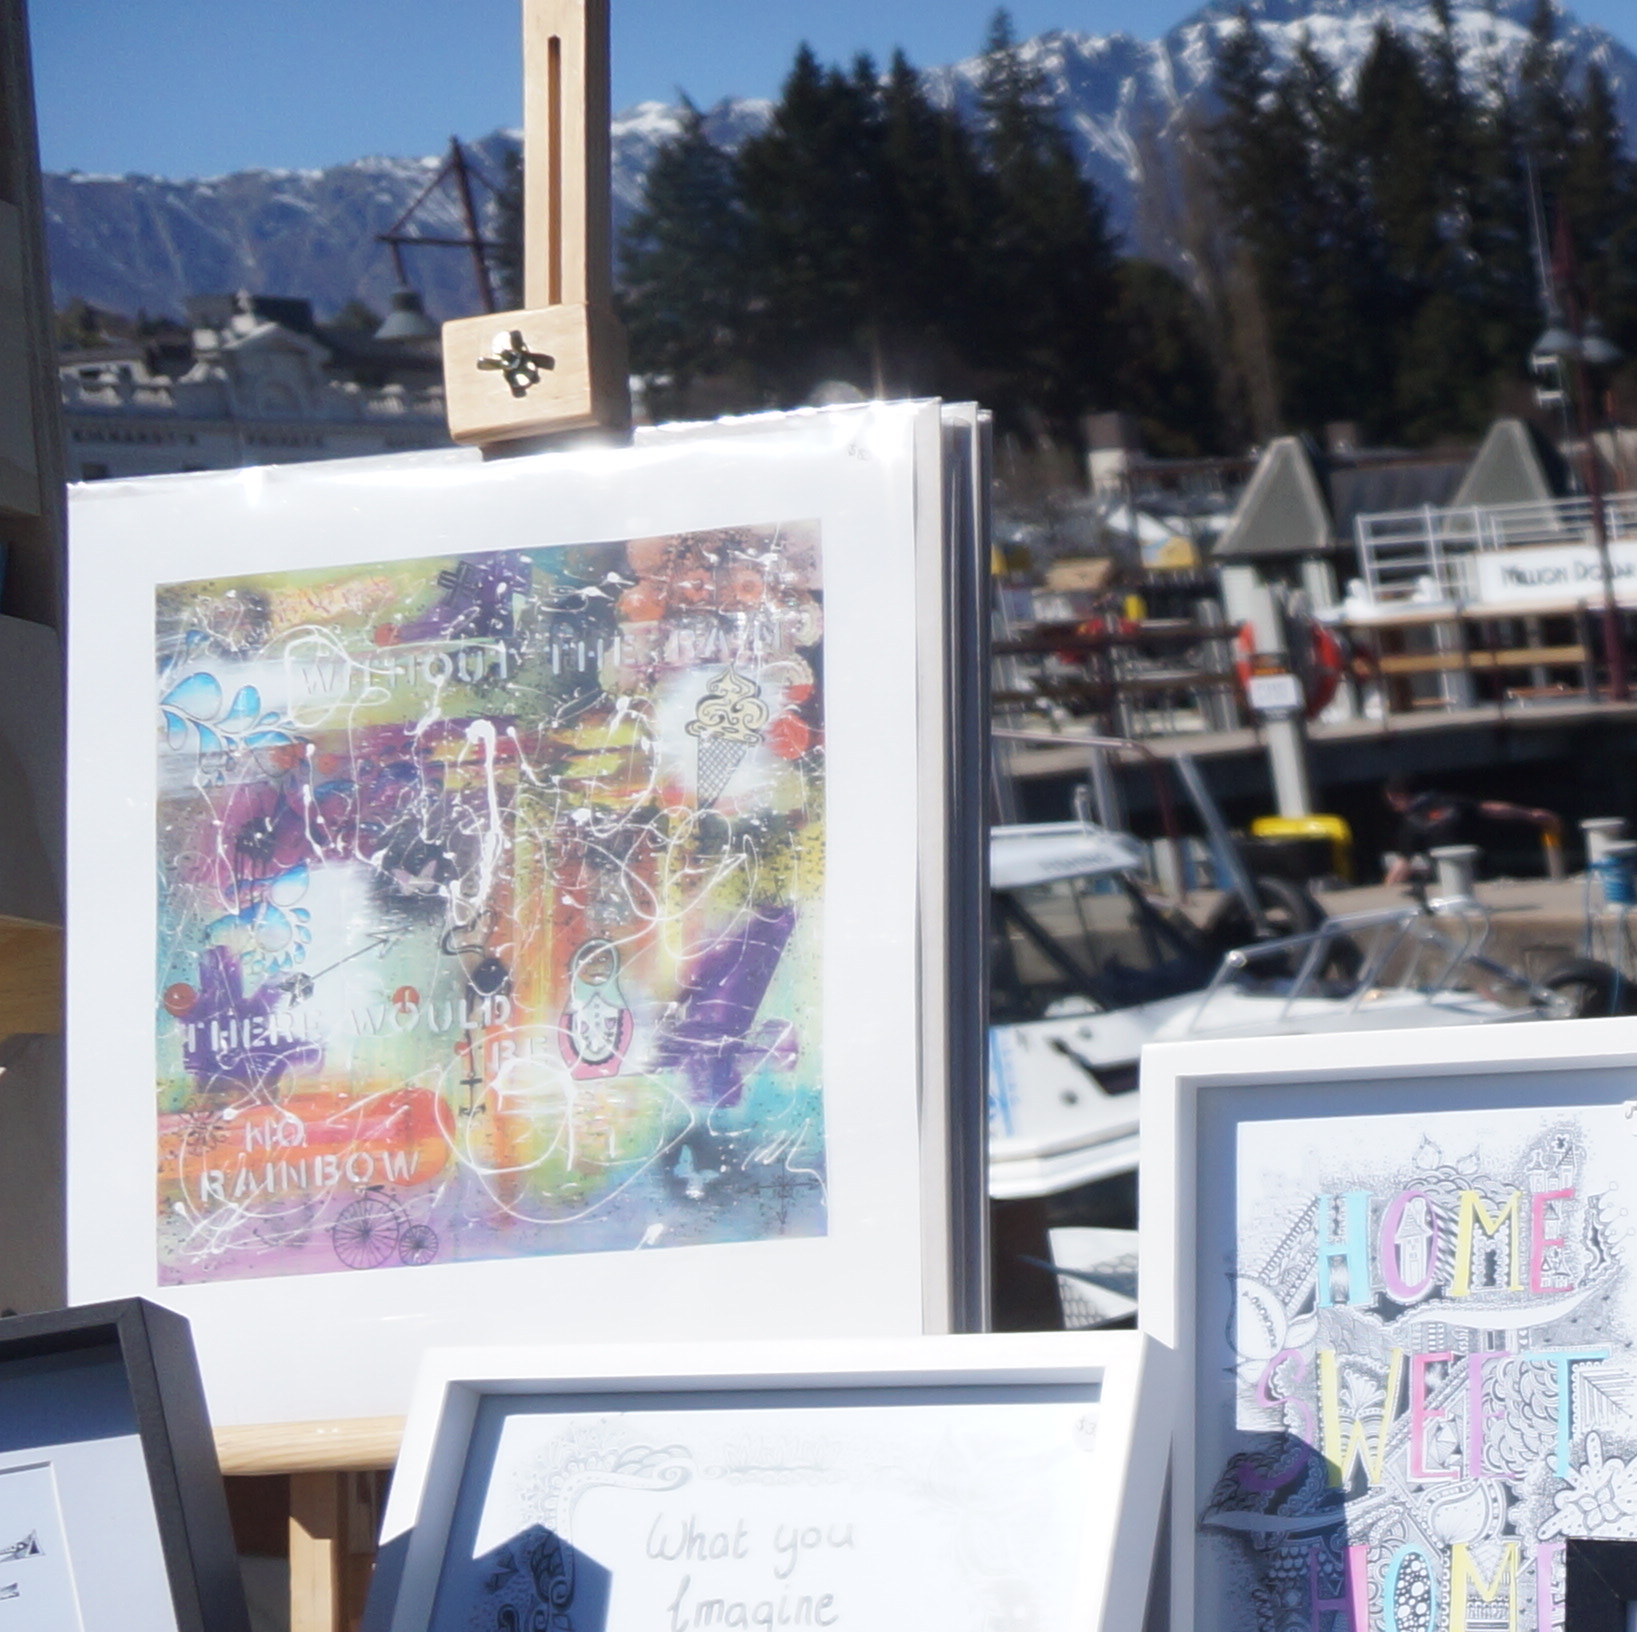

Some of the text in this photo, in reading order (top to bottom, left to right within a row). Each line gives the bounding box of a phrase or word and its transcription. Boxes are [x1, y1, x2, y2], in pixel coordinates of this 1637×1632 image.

[1573, 558, 1636, 582] DOAR
[302, 622, 783, 696] WITHOUT THE RAIN
[183, 992, 512, 1053] THERE WOULD
[490, 1034, 548, 1074] BE
[244, 1115, 305, 1154] NO
[200, 1148, 422, 1201] RAINBOW
[1316, 1188, 1575, 1308] HOME
[1236, 1348, 1610, 1492] SWEET
[645, 1512, 856, 1579] What you
